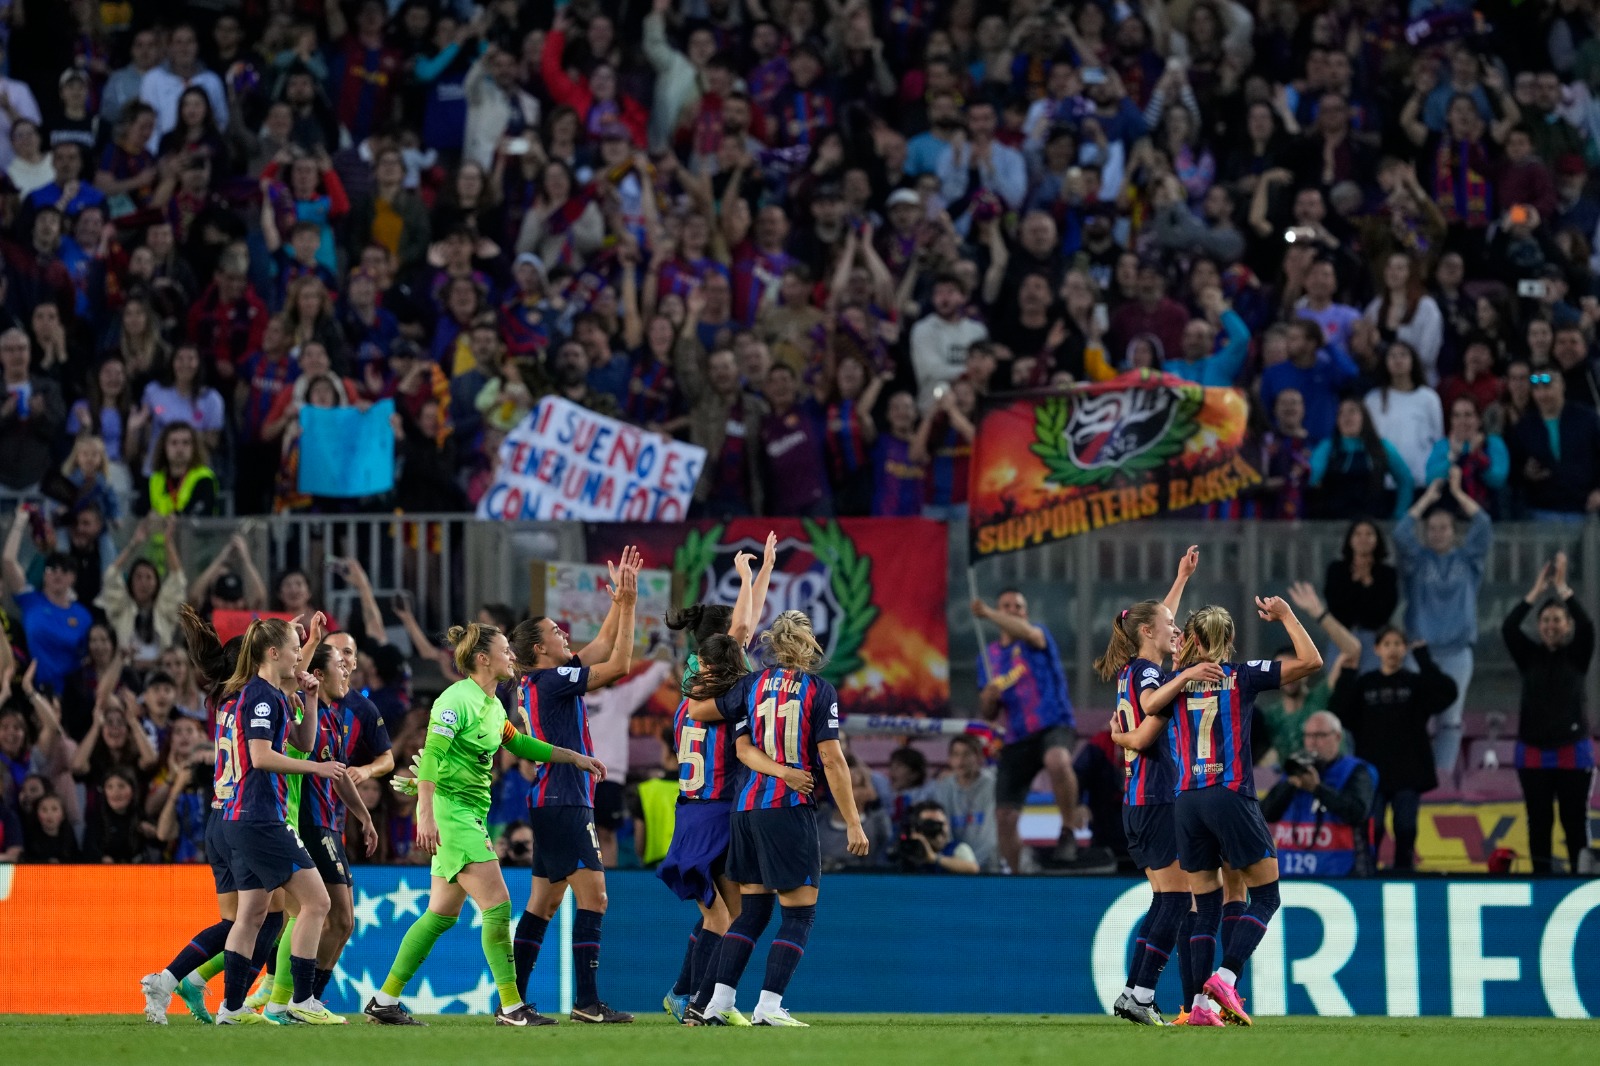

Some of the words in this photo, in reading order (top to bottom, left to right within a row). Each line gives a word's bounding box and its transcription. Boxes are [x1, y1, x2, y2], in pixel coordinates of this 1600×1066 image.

[504, 438, 567, 488] TENER
[562, 462, 618, 509] UNA
[557, 410, 656, 479] SUEÑO
[660, 451, 697, 494] ES
[976, 481, 1158, 554] SUPPORTERS
[762, 677, 802, 695] ALEXIA
[756, 697, 802, 765] 11
[1187, 695, 1219, 759] 7
[1284, 853, 1318, 875] 129
